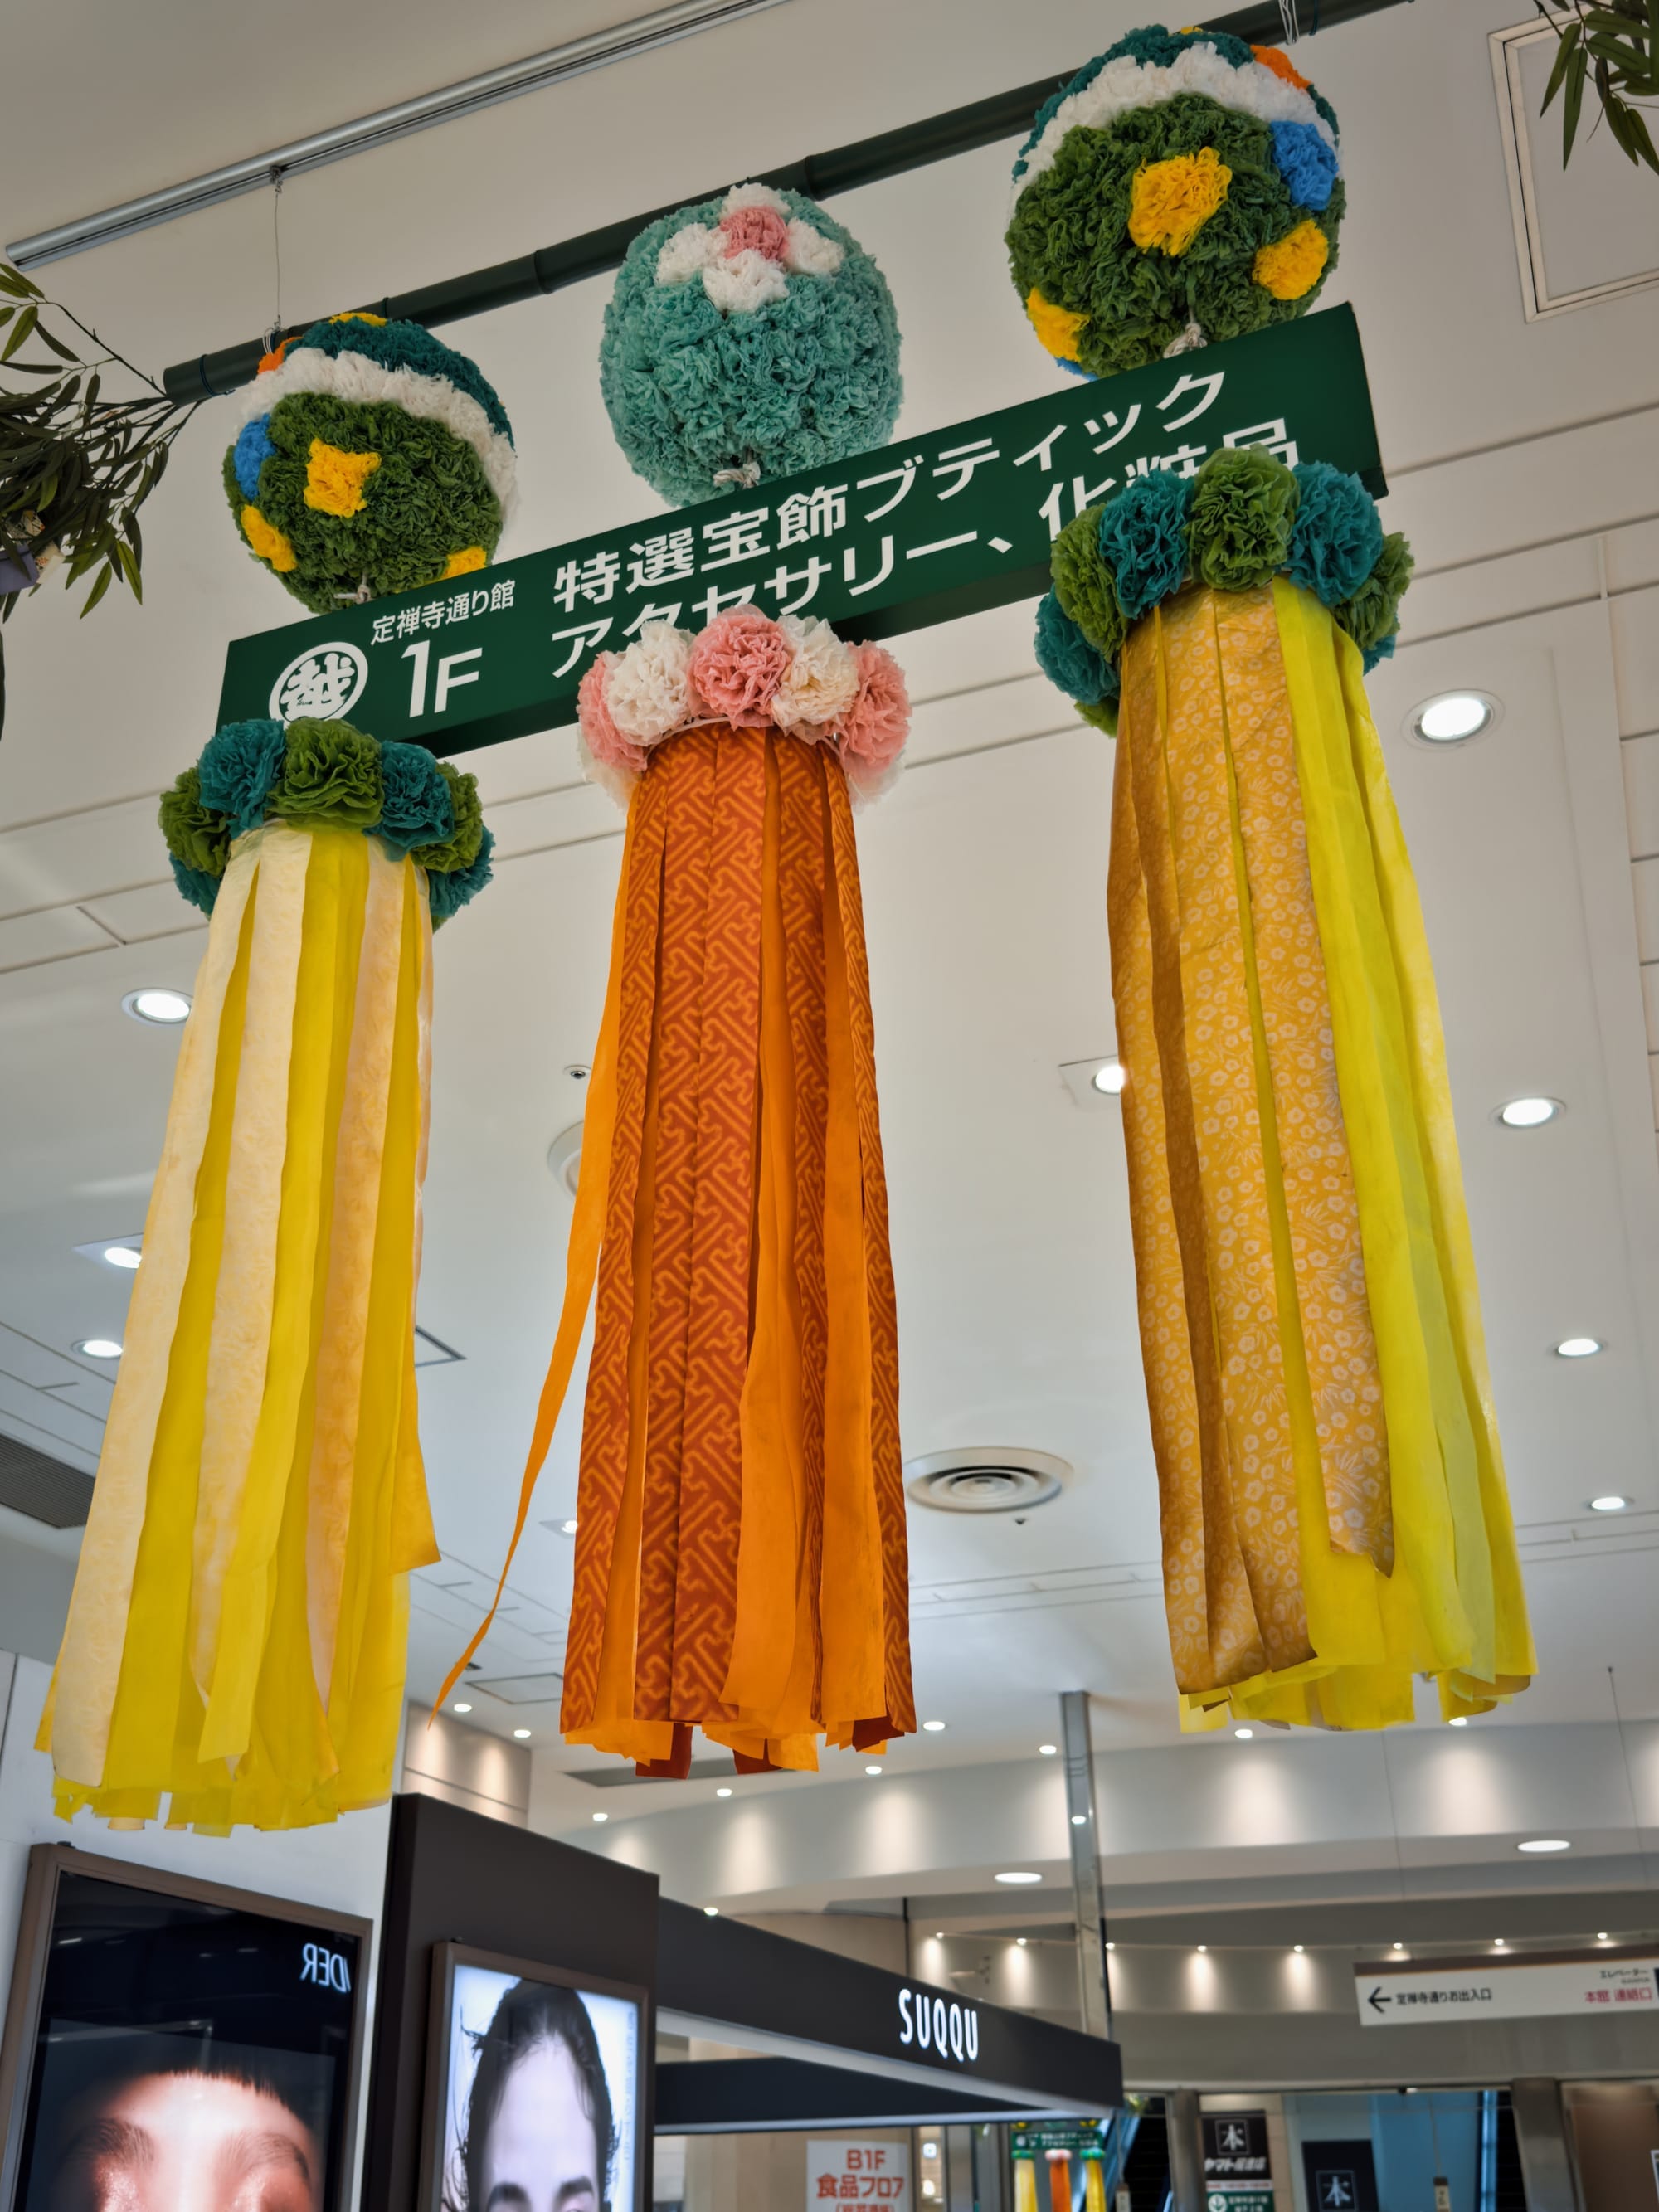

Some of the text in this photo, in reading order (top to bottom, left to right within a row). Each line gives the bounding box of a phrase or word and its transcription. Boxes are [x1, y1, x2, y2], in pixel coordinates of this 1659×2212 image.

[553, 372, 1225, 613] 特選宝飾ブティック
[370, 580, 515, 645] 定禅寺通り館
[401, 639, 483, 718] 1F
[898, 1988, 979, 2063] SUQQU
[847, 2149, 885, 2171] B1F
